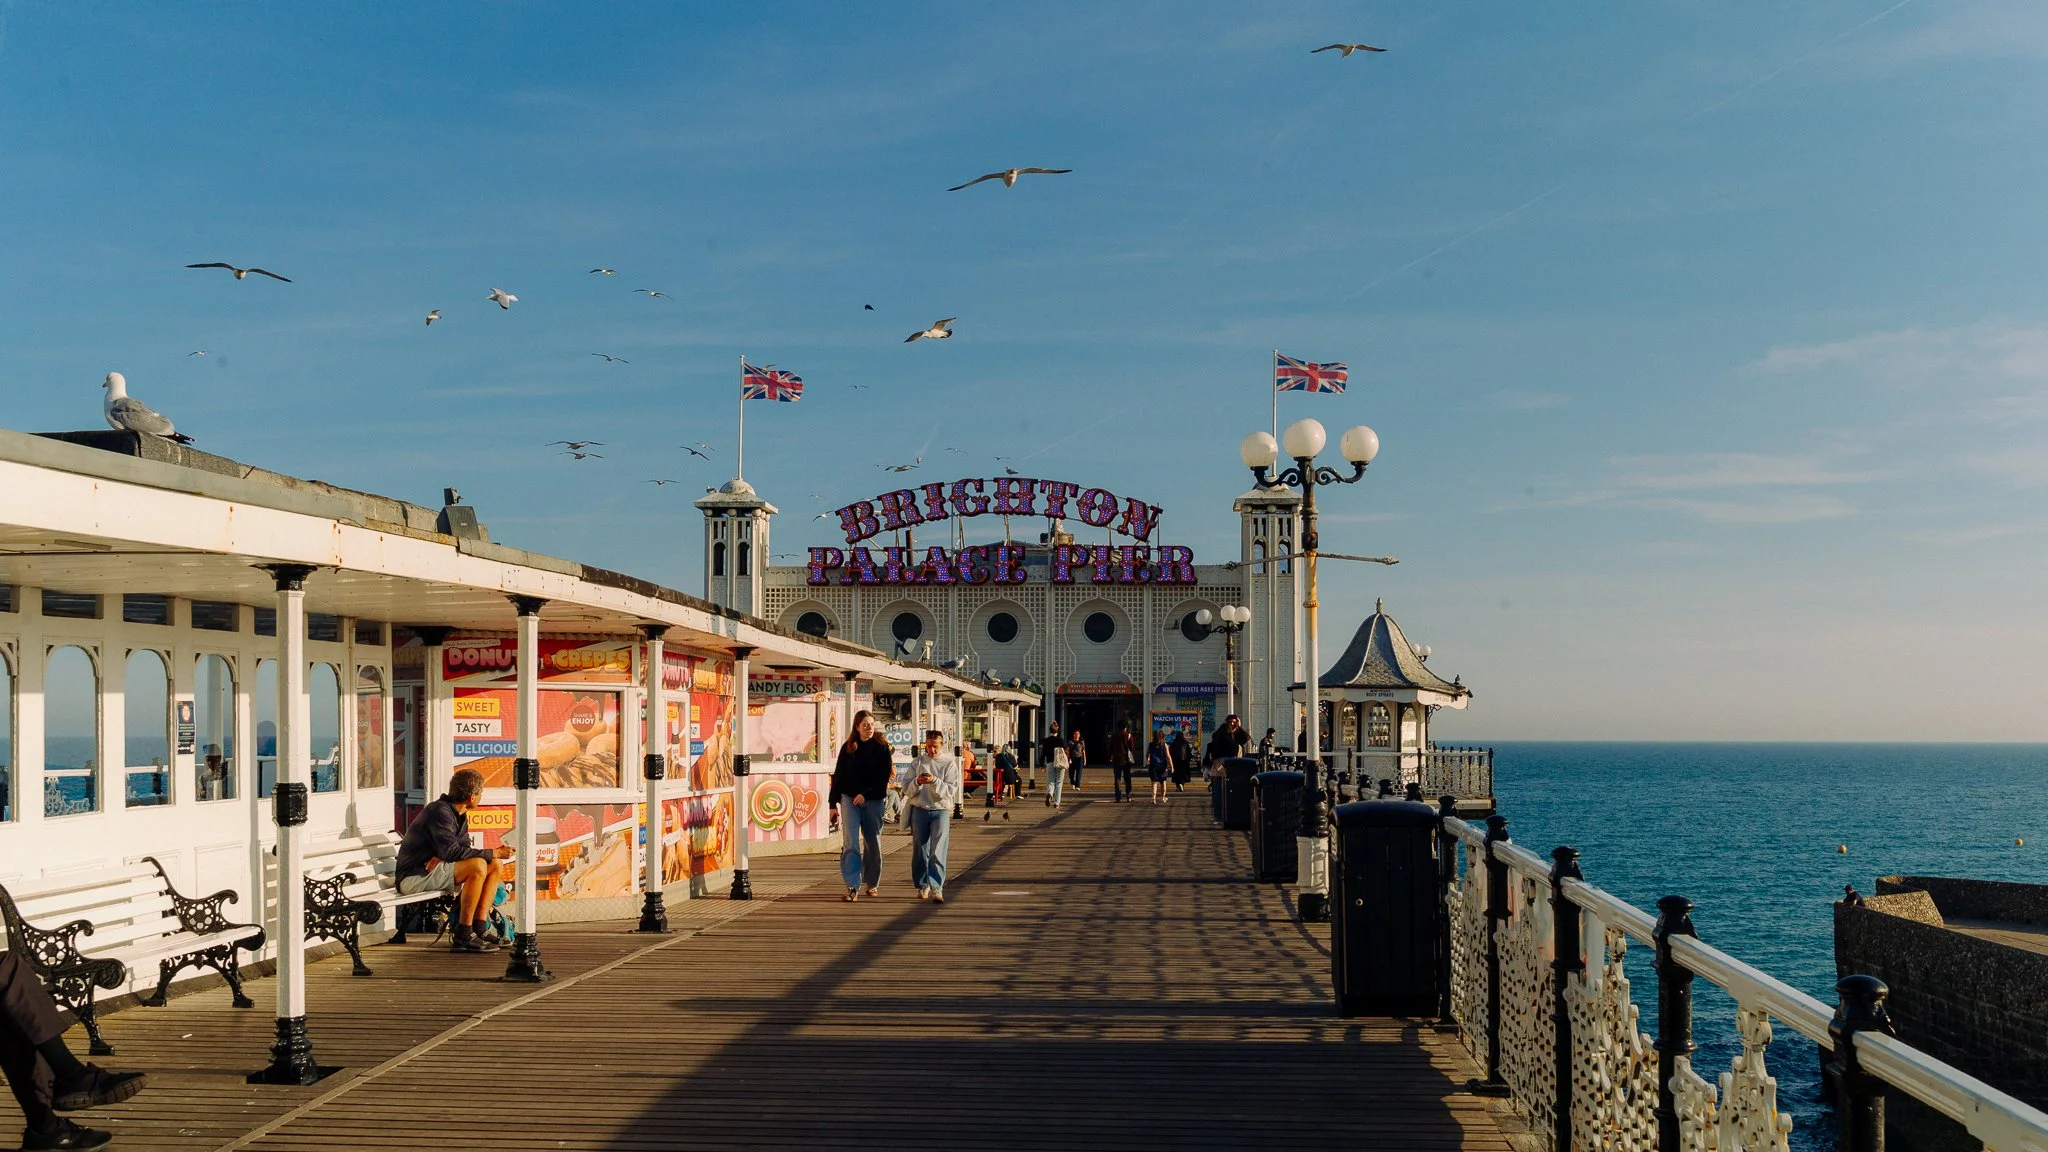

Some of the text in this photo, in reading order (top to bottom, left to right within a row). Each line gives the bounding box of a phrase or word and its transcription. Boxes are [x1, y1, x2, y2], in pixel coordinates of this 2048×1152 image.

[835, 477, 1163, 544] BRIGHTON
[806, 545, 1198, 586] PALACE PIER
[555, 649, 630, 672] CREPES
[748, 682, 781, 693] ANDY
[783, 683, 818, 694] FLOSS
[456, 702, 495, 712] SWEET
[456, 723, 491, 733] TASTY
[886, 731, 912, 744] COO
[455, 743, 517, 754] DELICIOUS
[795, 802, 810, 811] LOVE
[468, 814, 510, 825] ICIOUS
[795, 810, 807, 818] YOU
